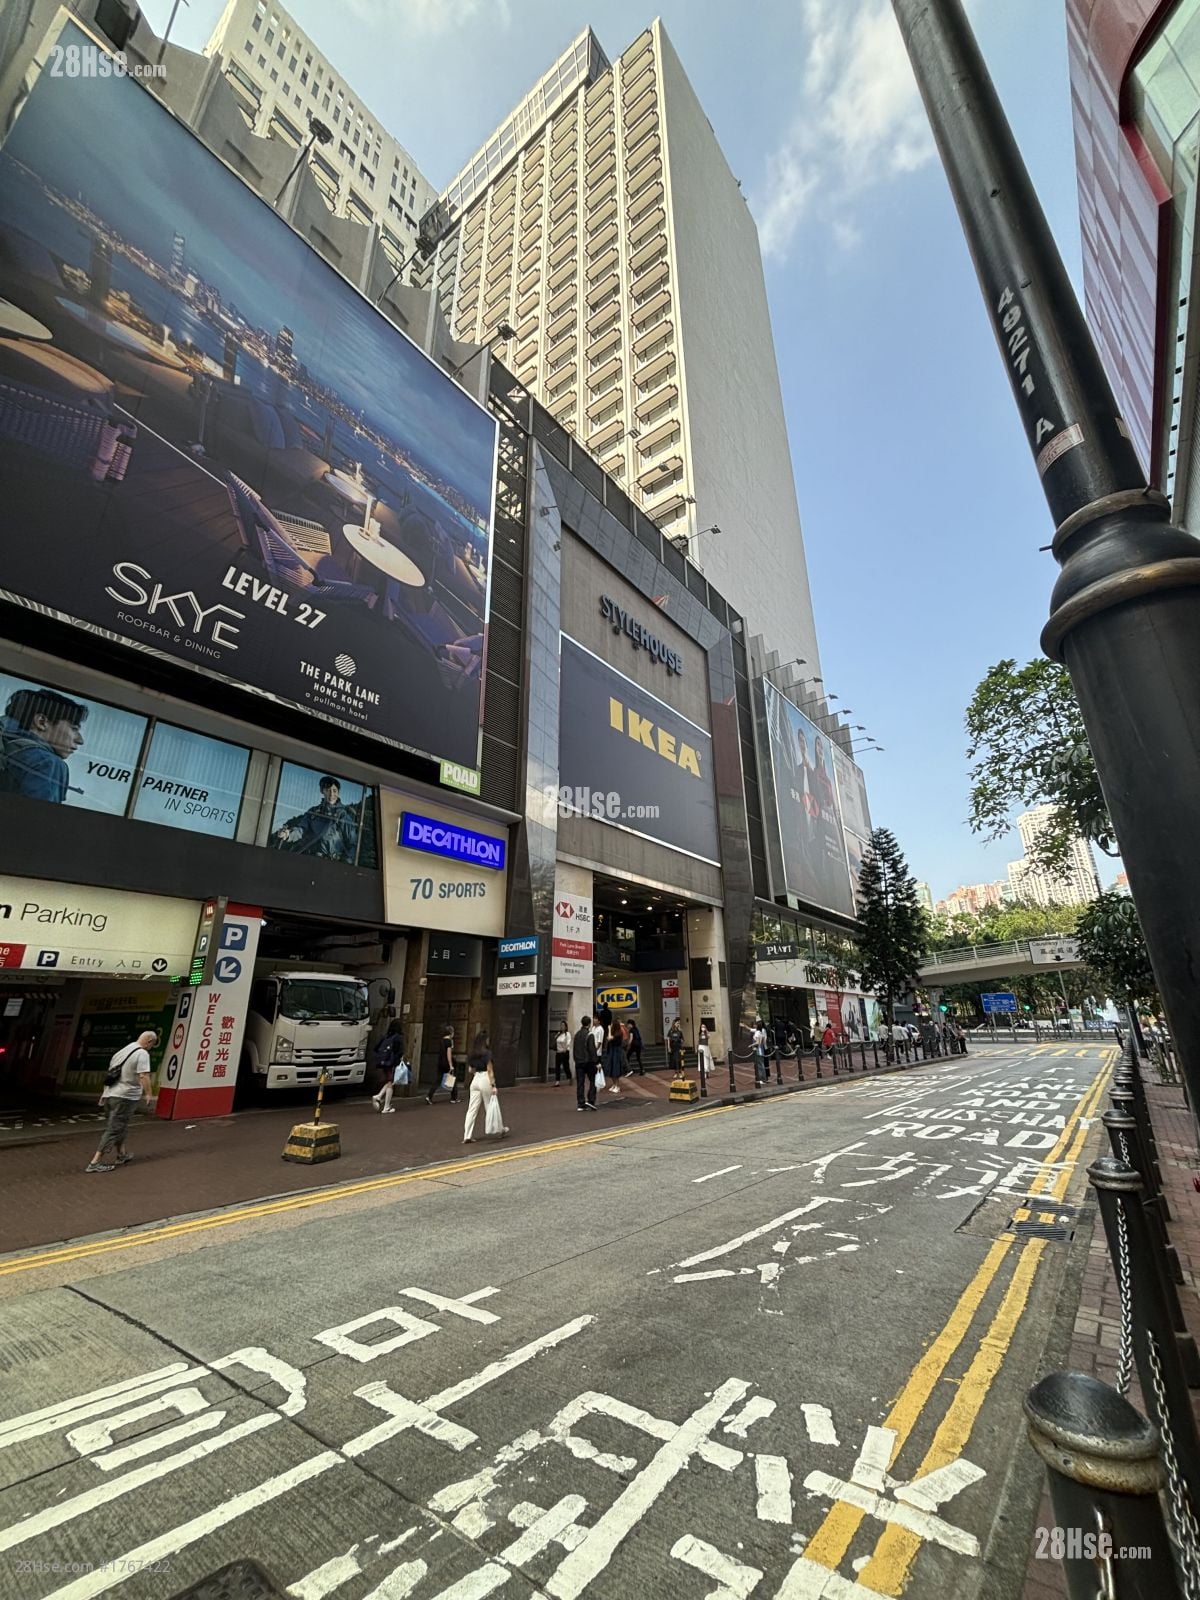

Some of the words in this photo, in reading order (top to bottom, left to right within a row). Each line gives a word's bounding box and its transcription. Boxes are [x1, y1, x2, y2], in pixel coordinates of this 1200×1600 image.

[1036, 417, 1055, 445] A
[105, 562, 246, 650] SKYE
[221, 565, 289, 616] LEVEL
[294, 603, 327, 629] 27
[117, 611, 170, 639] ROOFBAR
[173, 634, 182, 643] &
[185, 639, 222, 660] DINING
[600, 593, 685, 676] STYLEHOUSE
[300, 661, 321, 680] THE
[324, 672, 352, 693] PARK
[355, 686, 381, 706] LANE
[313, 682, 338, 699] HONG
[341, 694, 364, 710] KONG
[313, 694, 346, 713] pullman
[349, 707, 369, 721] hotel
[609, 696, 701, 778] IKEA
[87, 761, 131, 783] YOUR
[142, 776, 209, 802] PARTNER
[443, 762, 478, 788] POAD
[164, 797, 181, 812] IN
[183, 802, 236, 824] SPORTS
[408, 821, 500, 862] DECATHLON
[410, 878, 434, 900] 70
[438, 882, 486, 899] SPORTS
[20, 902, 108, 932] Parking
[575, 913, 591, 922] HSBC
[501, 940, 536, 953] DECATHLON
[71, 955, 104, 967] Entry
[600, 992, 634, 1003] IKEA
[196, 993, 221, 1072] WELCOME
[212, 1015, 235, 1078] 歡迎光臨
[958, 1088, 1085, 1100] ROAD
[978, 1081, 1092, 1092] HANG
[952, 1097, 1061, 1110] AND
[882, 1106, 1100, 1130] CAUSEWAY
[865, 1121, 1060, 1149] ROAD
